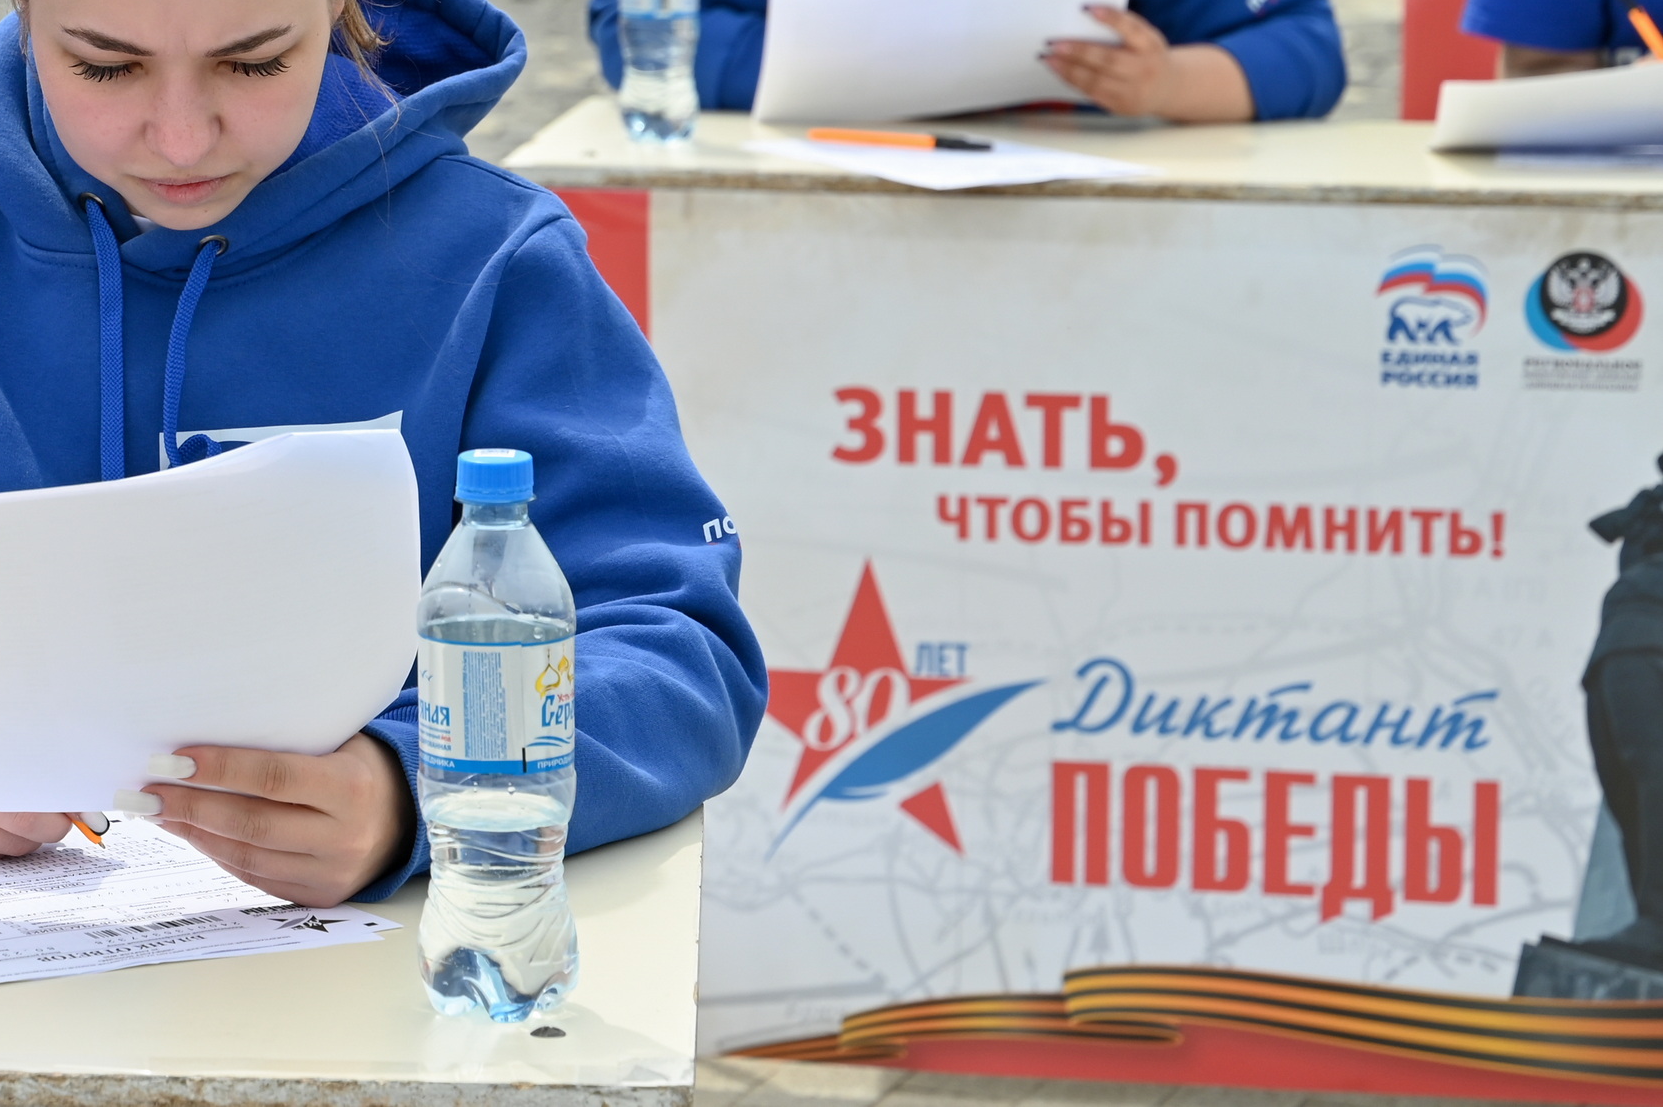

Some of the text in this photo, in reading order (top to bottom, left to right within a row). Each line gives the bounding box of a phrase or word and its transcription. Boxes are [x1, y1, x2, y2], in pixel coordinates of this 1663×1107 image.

[1380, 350, 1479, 367] ЕДИНАЯ
[1380, 370, 1479, 388] РОССИЯ
[831, 385, 1179, 486] ЗНАТЬ,
[936, 494, 1508, 559] ЧТОБЫ ПОМНИТЬ!
[802, 641, 970, 752] 80 ЛЕТ
[1050, 657, 1500, 751] Диктант
[1050, 760, 1501, 923] ПОБЕДЫ
